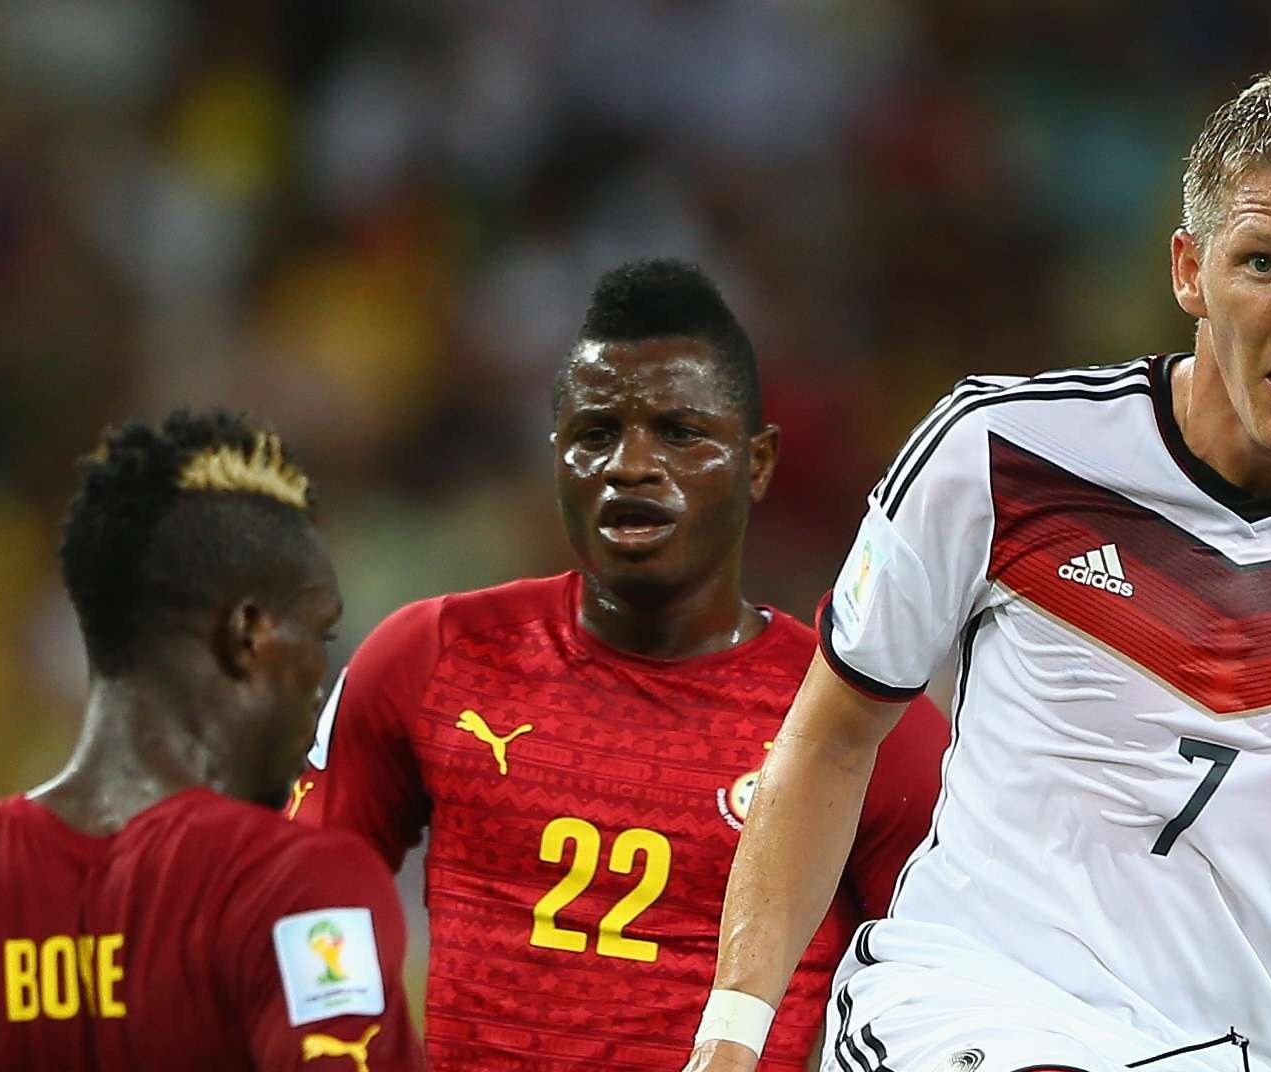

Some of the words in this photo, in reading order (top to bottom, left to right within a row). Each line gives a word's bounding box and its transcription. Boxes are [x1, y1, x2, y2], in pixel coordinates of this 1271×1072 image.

[1058, 564, 1134, 597] adidas
[1150, 736, 1240, 857] 7
[530, 817, 672, 963] 22
